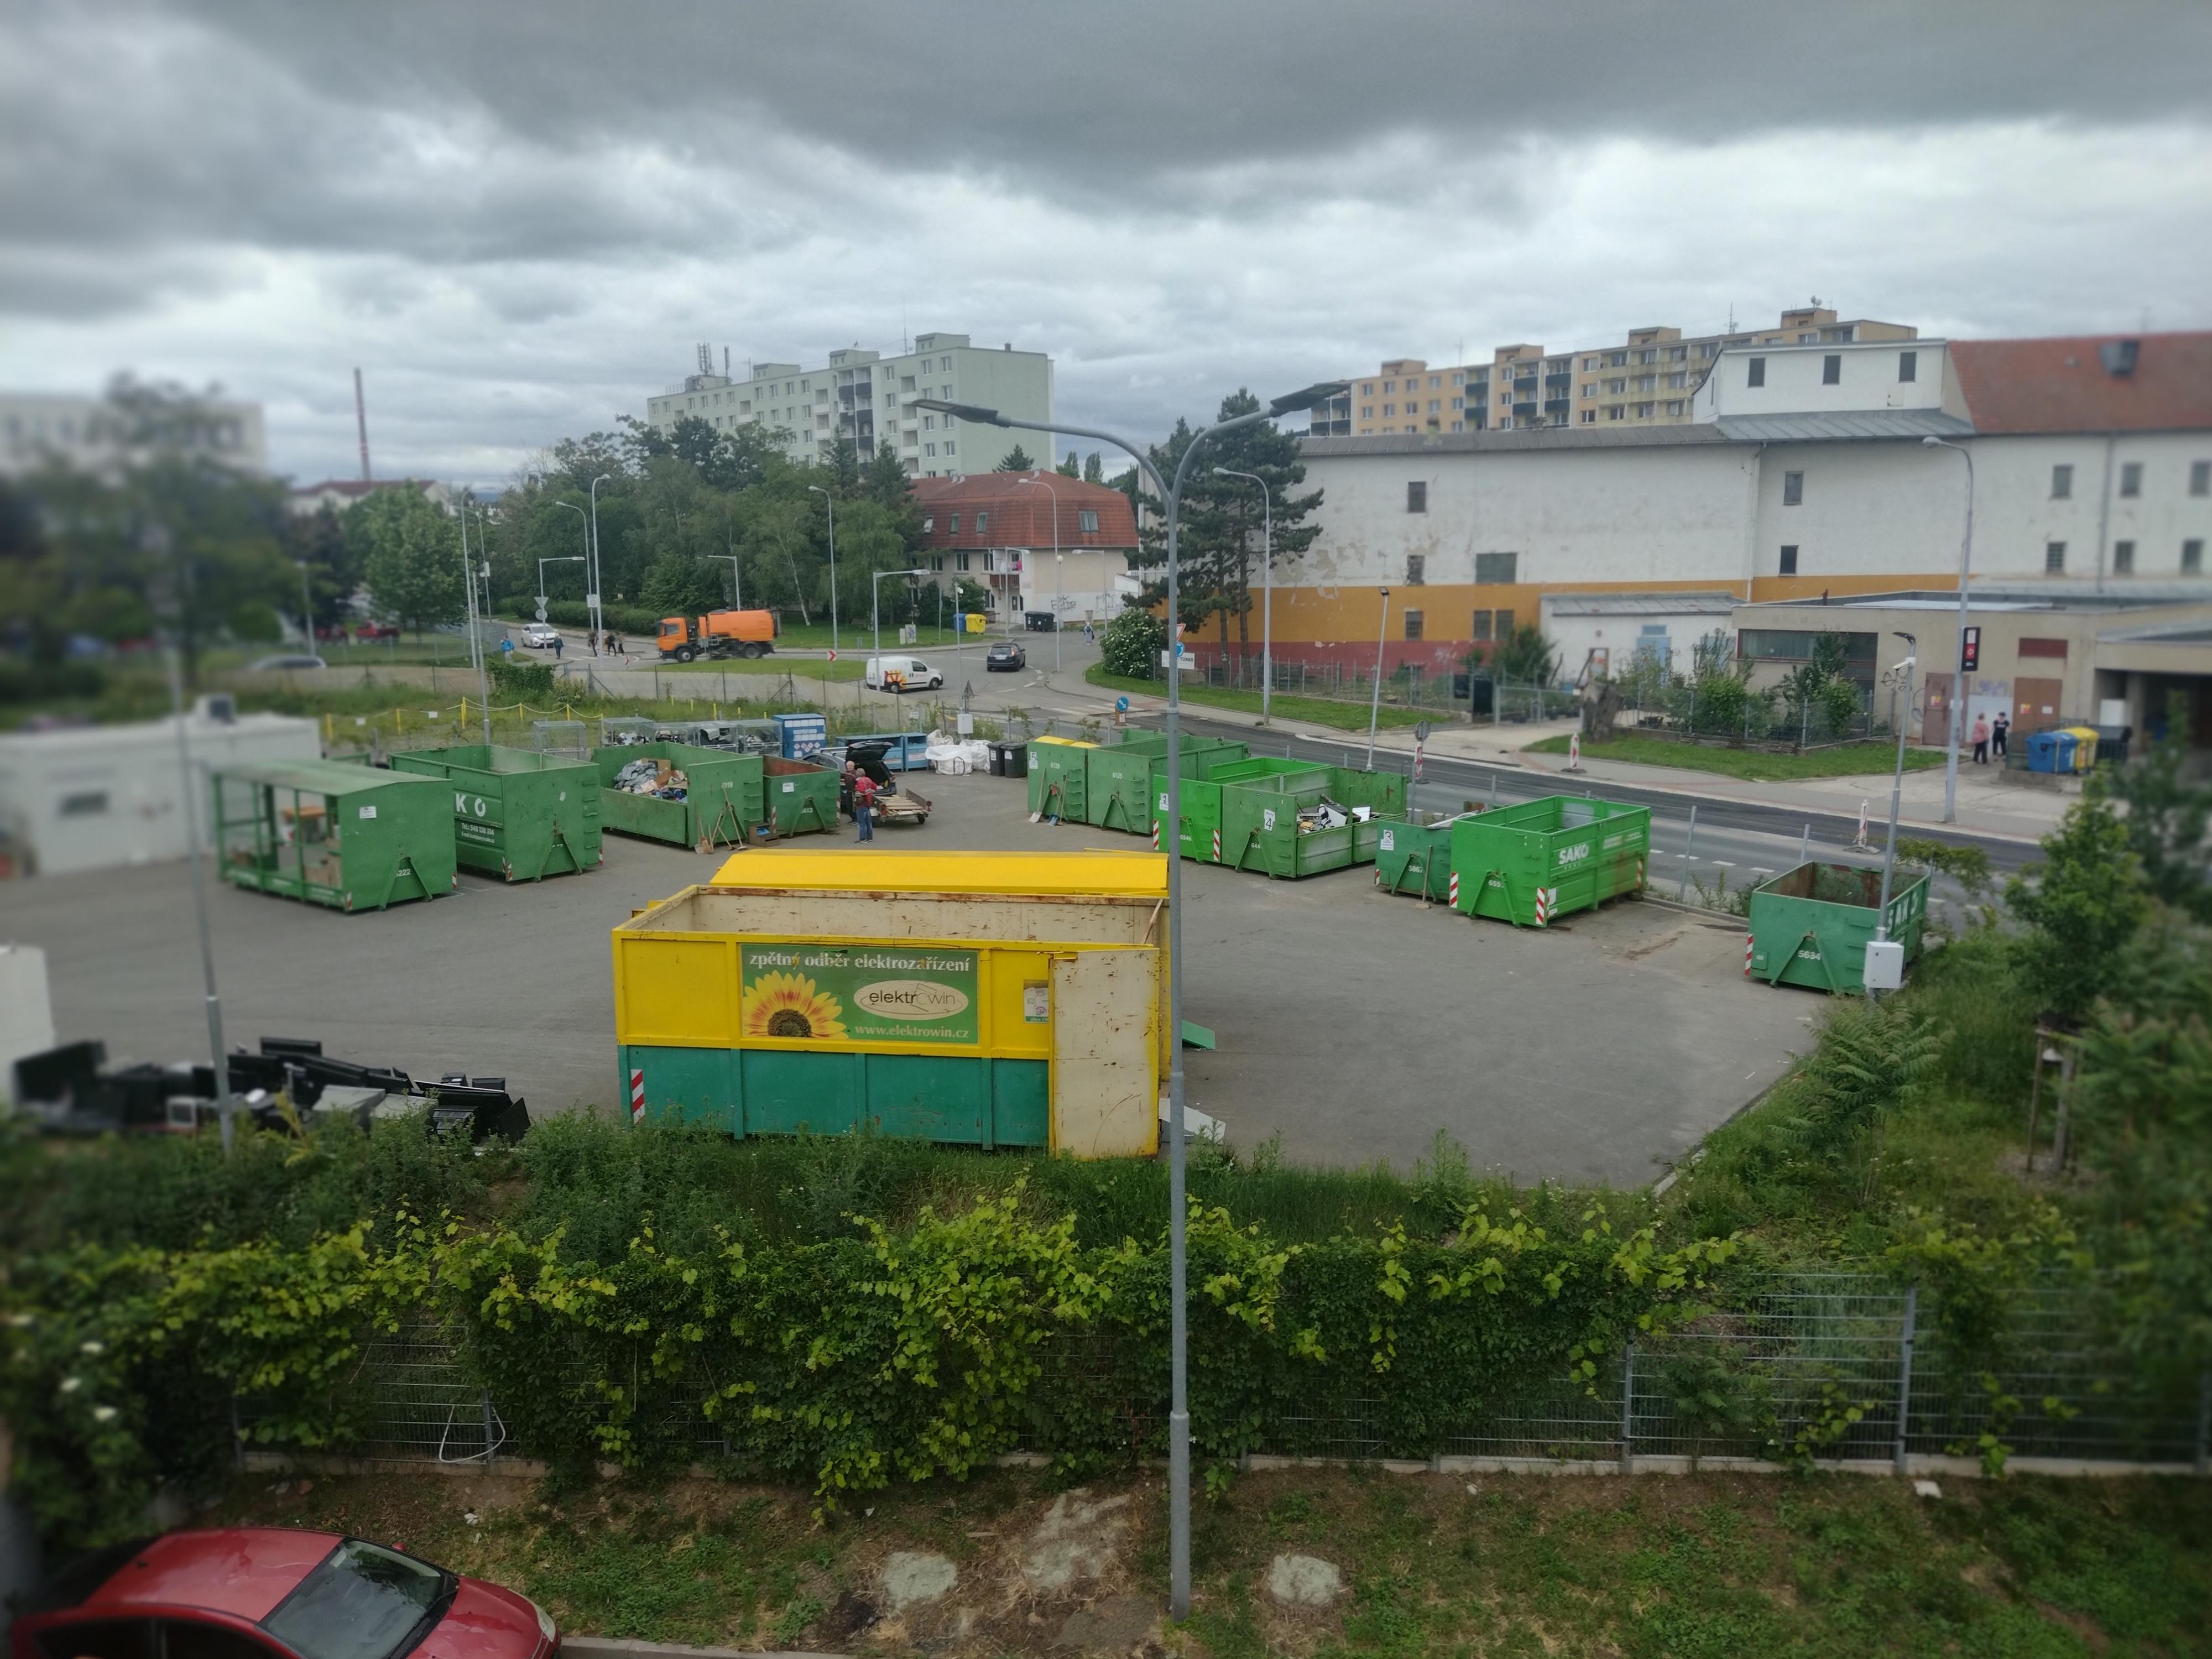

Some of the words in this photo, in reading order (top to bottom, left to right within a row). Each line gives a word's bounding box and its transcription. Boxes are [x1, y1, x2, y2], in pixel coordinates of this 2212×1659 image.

[1266, 818, 1272, 830] 4
[1558, 843, 1589, 865] SAKO
[805, 952, 850, 967] odběr
[854, 953, 971, 972] elektrozařízení
[855, 1024, 969, 1039] www.elektrowin.cz
